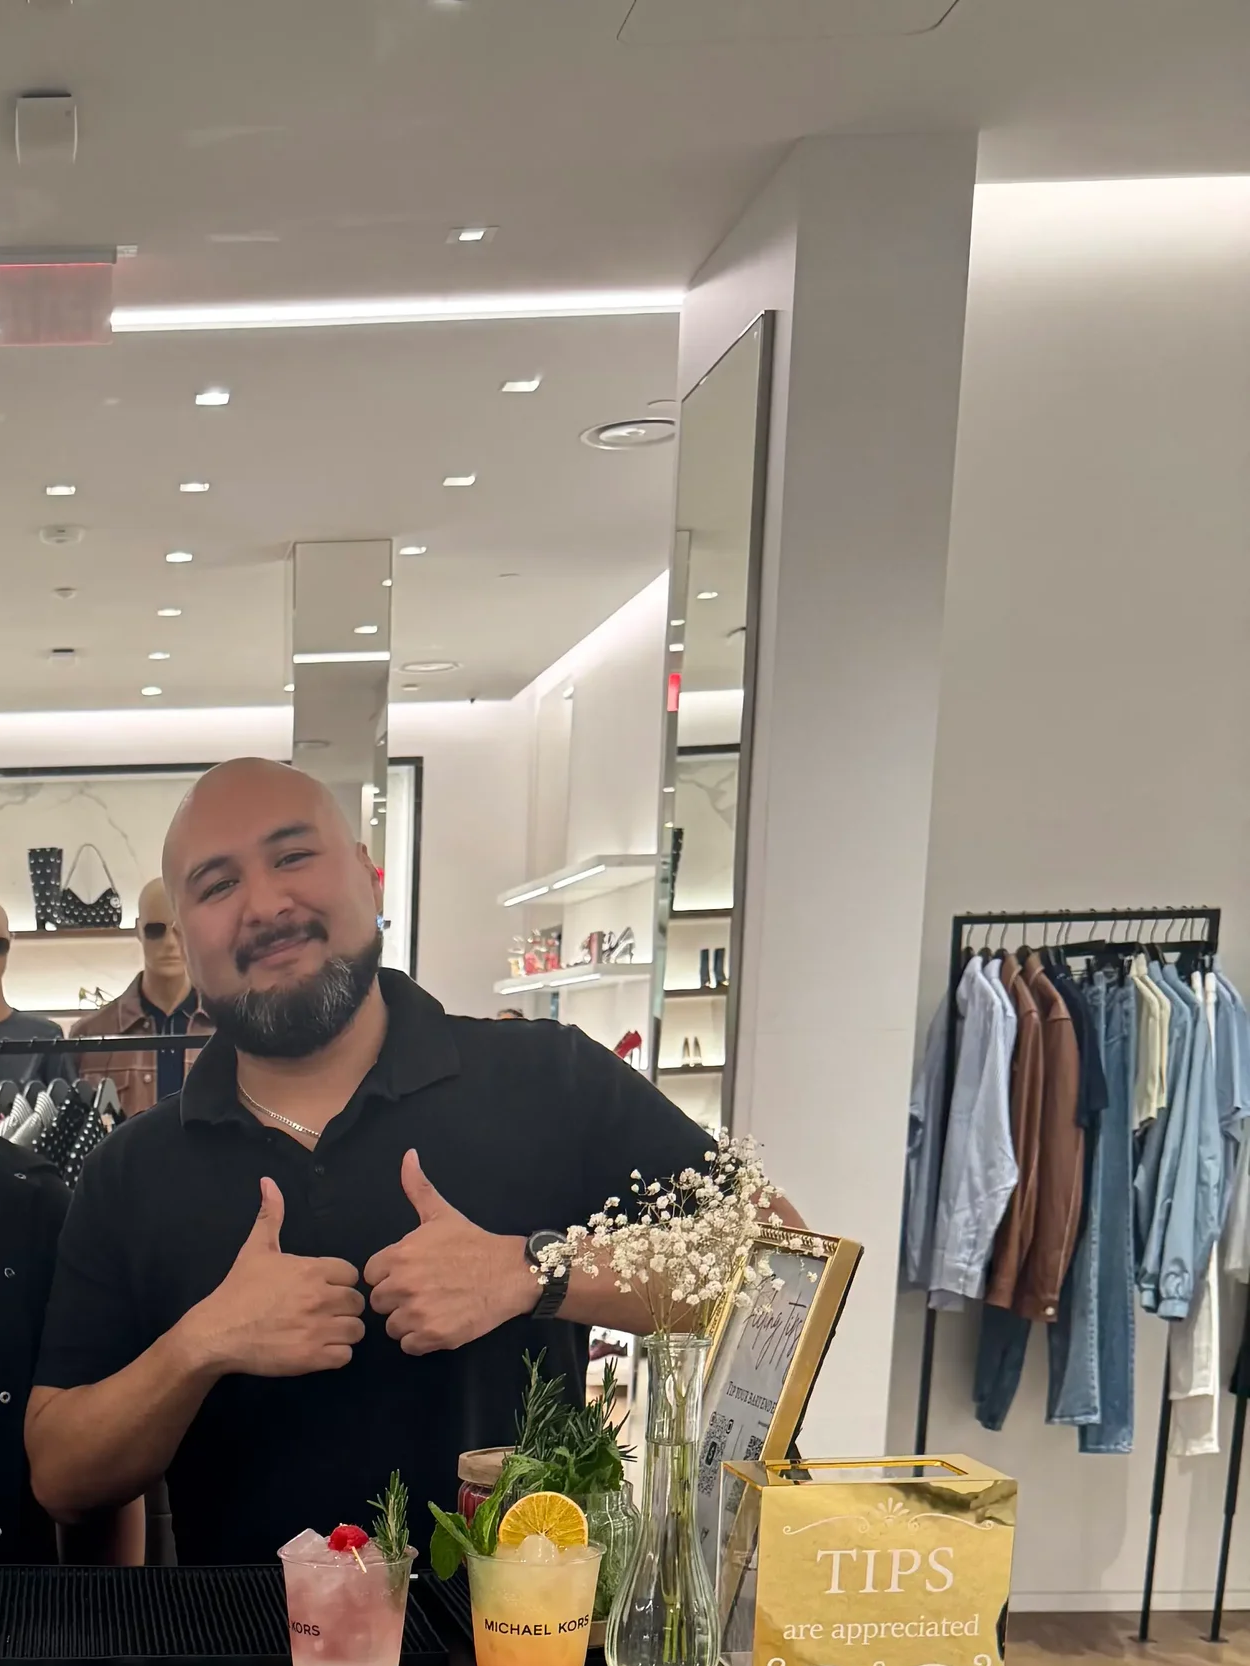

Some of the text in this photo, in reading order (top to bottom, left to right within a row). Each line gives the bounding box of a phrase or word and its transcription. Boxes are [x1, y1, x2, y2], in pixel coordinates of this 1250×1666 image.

[816, 1546, 954, 1594] TIPS
[291, 1620, 321, 1637] KORS
[484, 1614, 589, 1636] MICHAEL KORS
[782, 1614, 980, 1646] are appreciated
